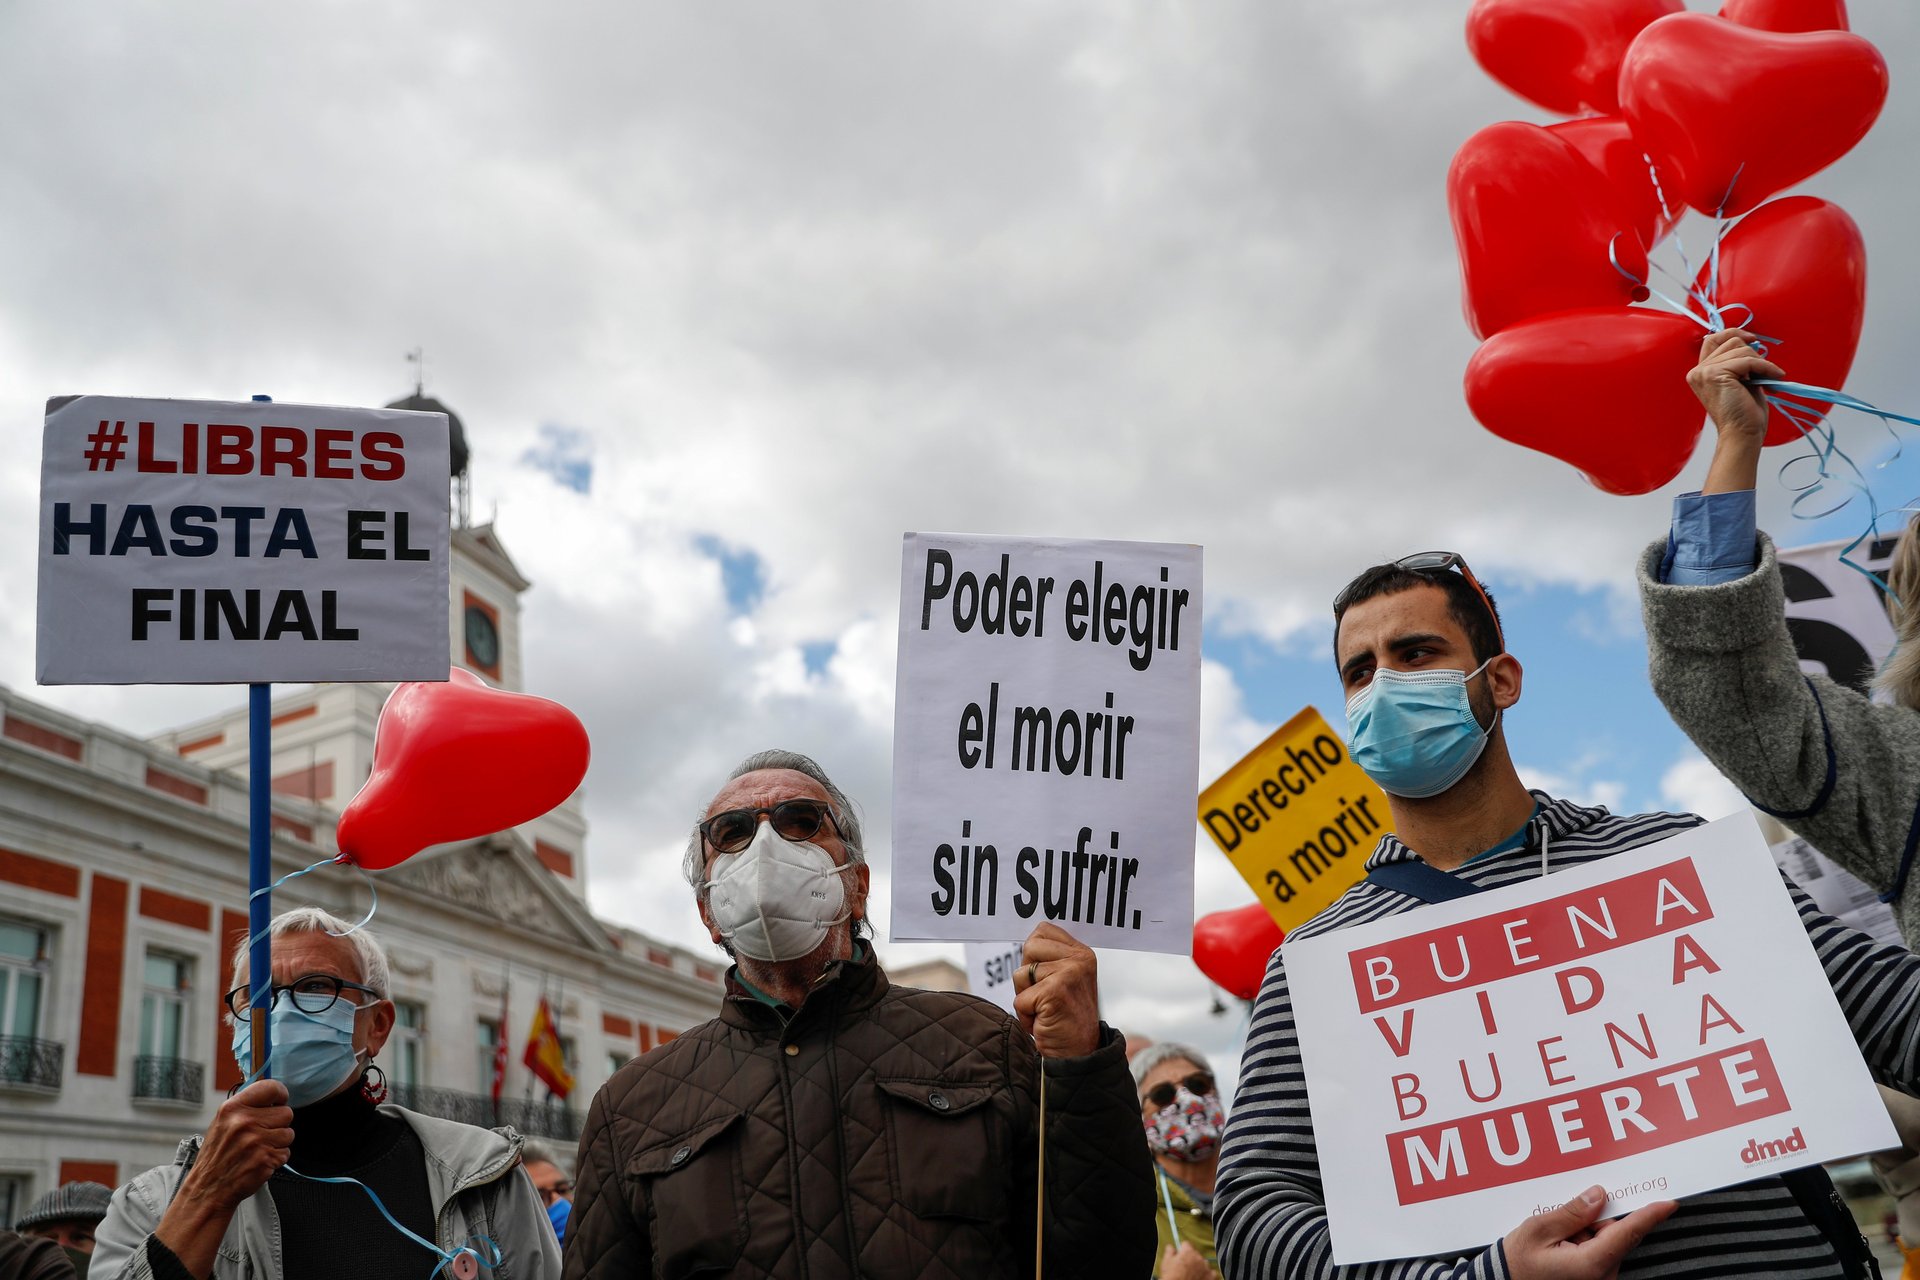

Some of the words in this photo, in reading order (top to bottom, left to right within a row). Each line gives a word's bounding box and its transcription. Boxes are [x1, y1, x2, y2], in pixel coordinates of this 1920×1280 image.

[84, 420, 406, 481] #LIBRES
[53, 502, 319, 559] HASTA
[347, 510, 431, 561] EL
[131, 588, 360, 641] FINAL
[921, 548, 1054, 638] Poder
[1065, 560, 1190, 672] elegir
[957, 682, 1000, 770] el
[1011, 692, 1135, 780] morir
[1203, 734, 1342, 852] Derecho
[930, 820, 999, 917] sin
[1012, 826, 1142, 930] sufrir.
[1265, 868, 1298, 904] a
[1288, 795, 1381, 884] morir
[1364, 878, 1700, 1002] BUENA
[1372, 933, 1722, 1058] VIDA
[1391, 993, 1745, 1121] BUENA
[1402, 1050, 1770, 1187] MUERTE
[1740, 1126, 1807, 1164] dmd
